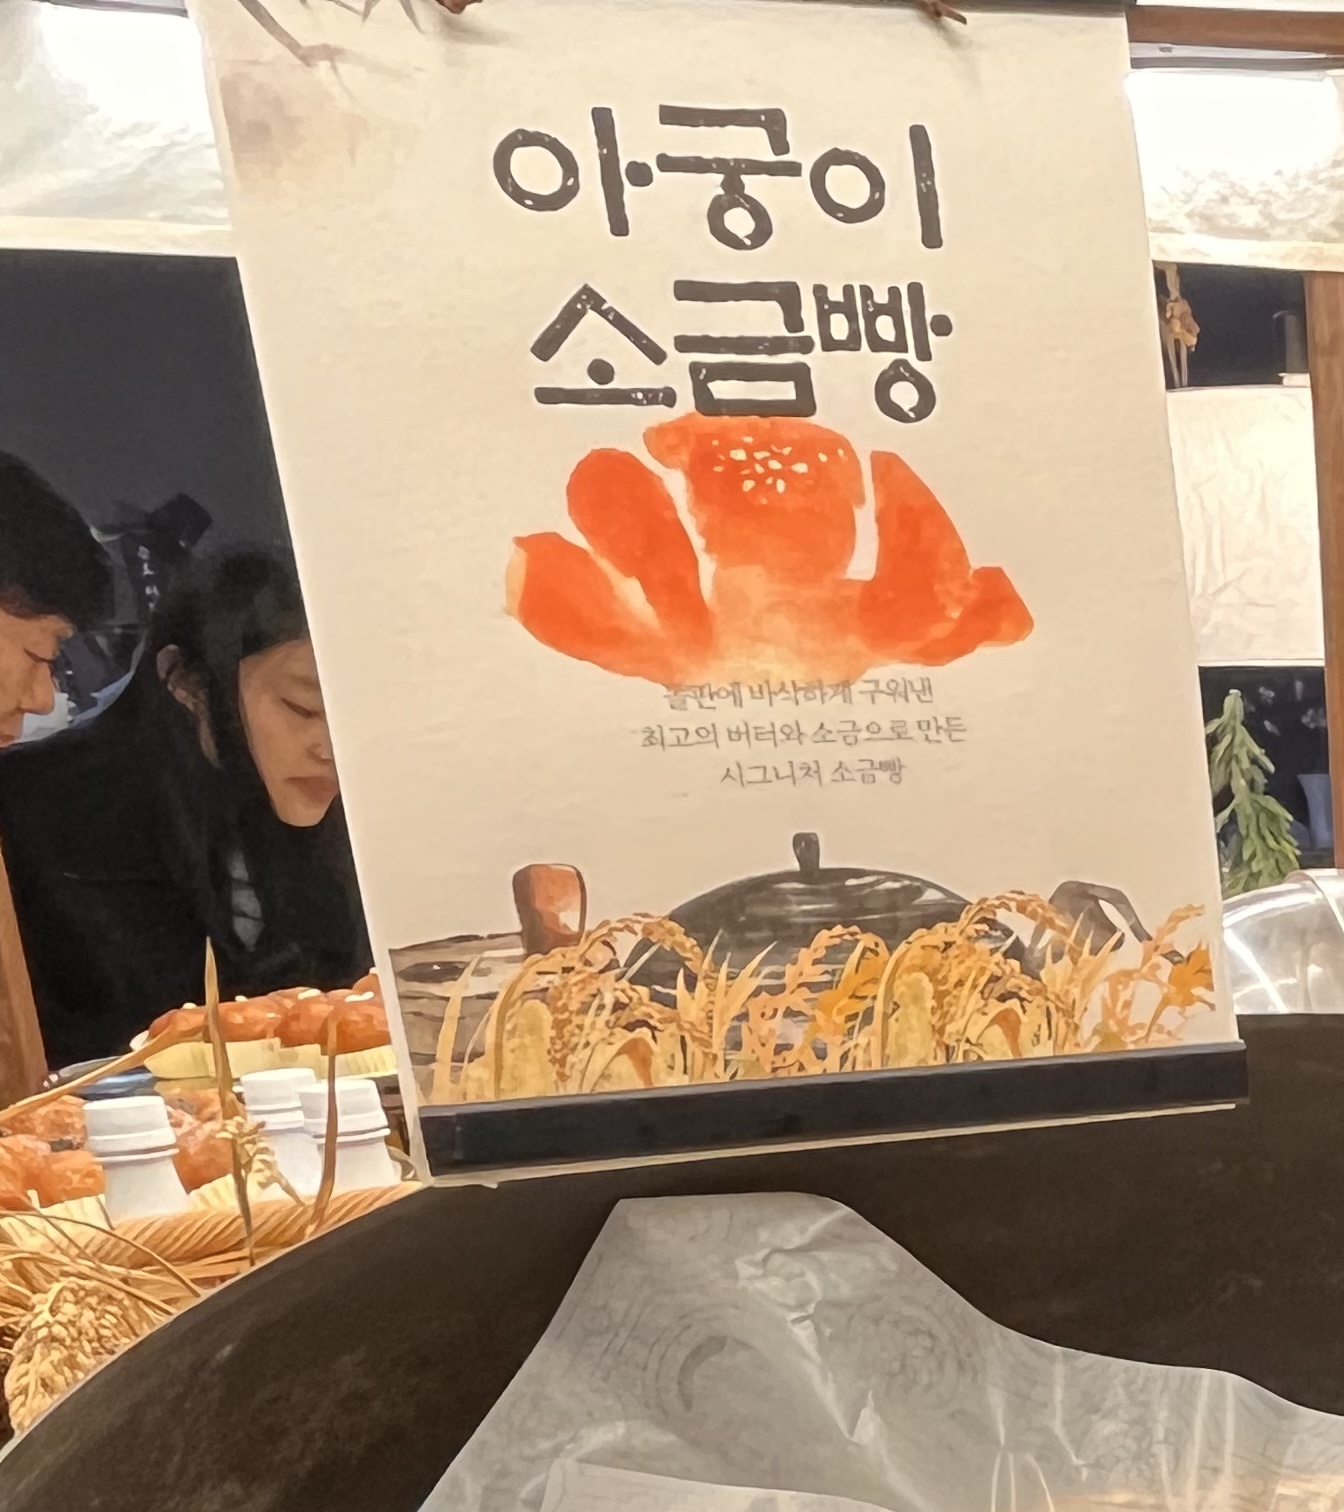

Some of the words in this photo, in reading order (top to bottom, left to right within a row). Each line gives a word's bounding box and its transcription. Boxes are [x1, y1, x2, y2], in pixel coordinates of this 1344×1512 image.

[493, 104, 943, 250] 아궁이
[530, 280, 953, 423] 소금빵
[749, 678, 853, 706] 바삭하게
[859, 676, 934, 704] 구워낸
[641, 722, 719, 751] 최고의
[727, 720, 805, 748] 버터와
[811, 720, 915, 747] 소금으로
[917, 716, 968, 744] 만든
[720, 760, 824, 788] 시그니처
[830, 757, 907, 785] 소금빵
